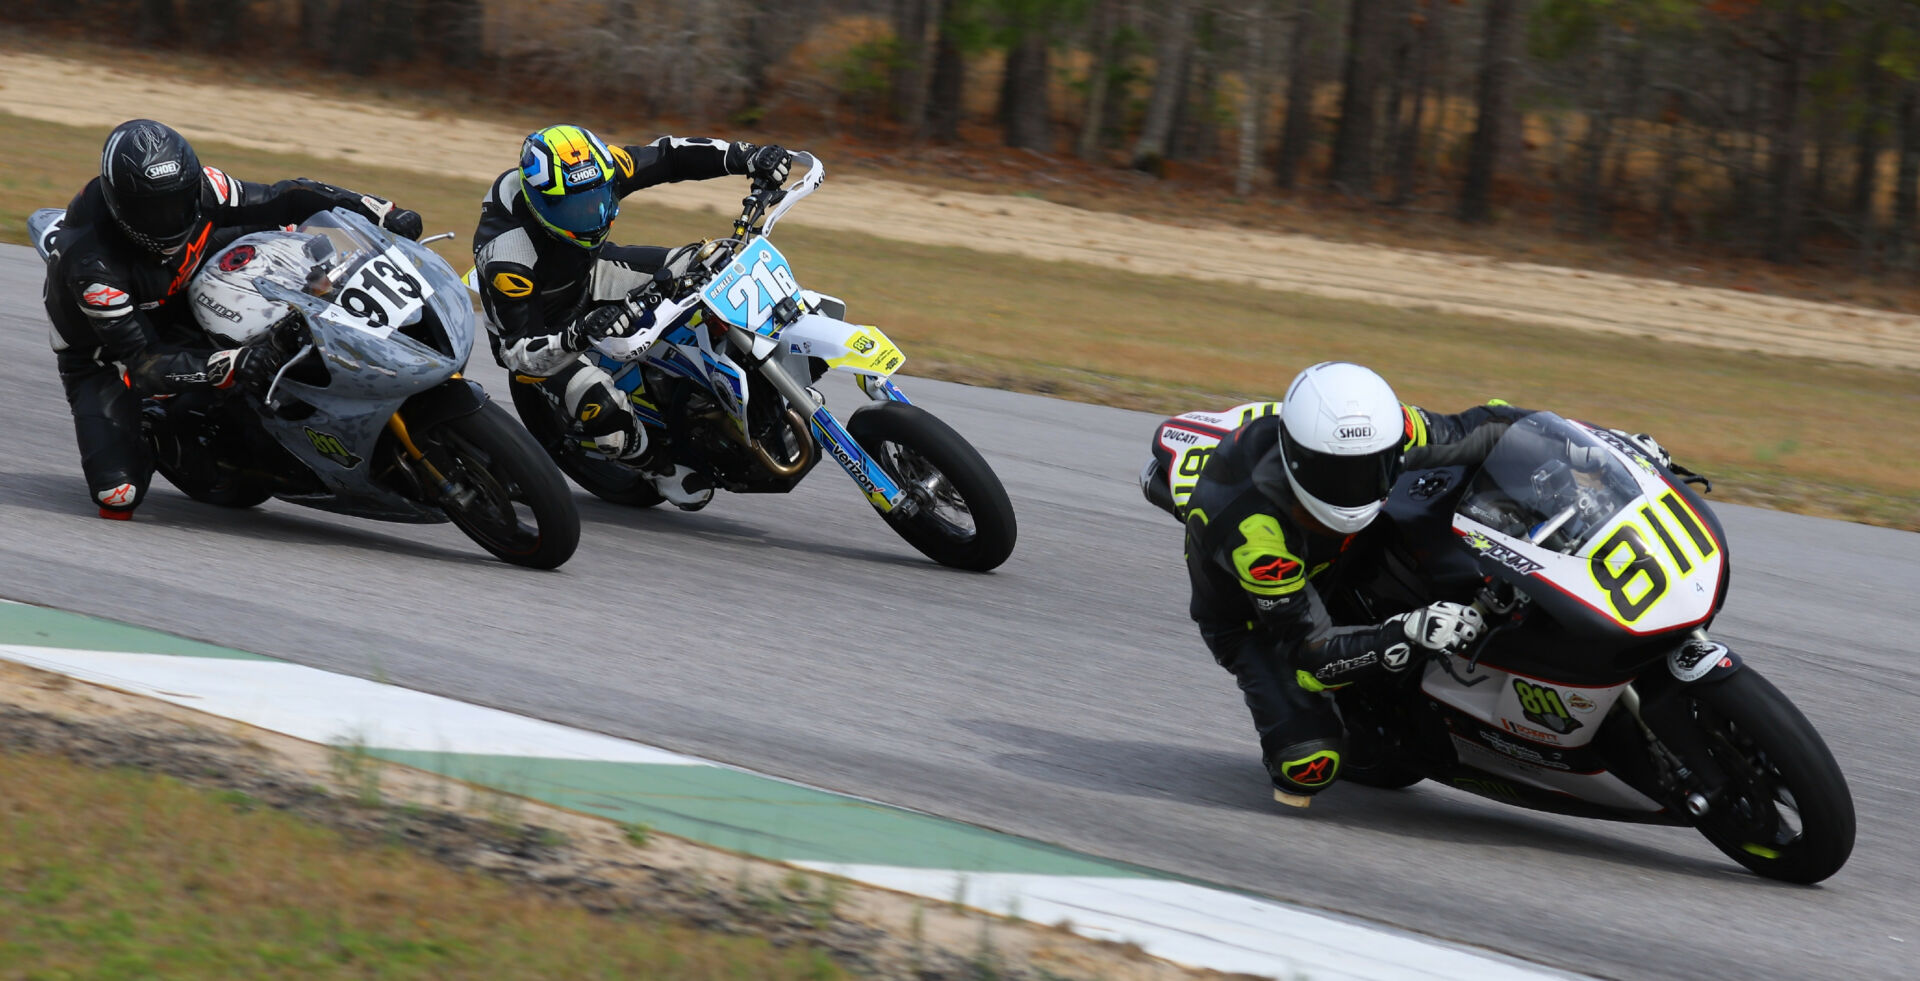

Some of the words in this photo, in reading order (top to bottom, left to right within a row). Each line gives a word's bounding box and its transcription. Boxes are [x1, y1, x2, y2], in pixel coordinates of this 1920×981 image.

[150, 163, 177, 177] SHOEI
[571, 168, 597, 182] SHOEI
[340, 260, 422, 328] 913
[709, 273, 735, 299] BERKLEY
[854, 335, 872, 353] 811
[304, 428, 349, 457] 811
[1163, 429, 1199, 445] DUCATI
[1339, 426, 1372, 439] SHOEI
[833, 444, 875, 493] verizon
[1587, 488, 1718, 626] 811
[1513, 679, 1570, 720] 811
